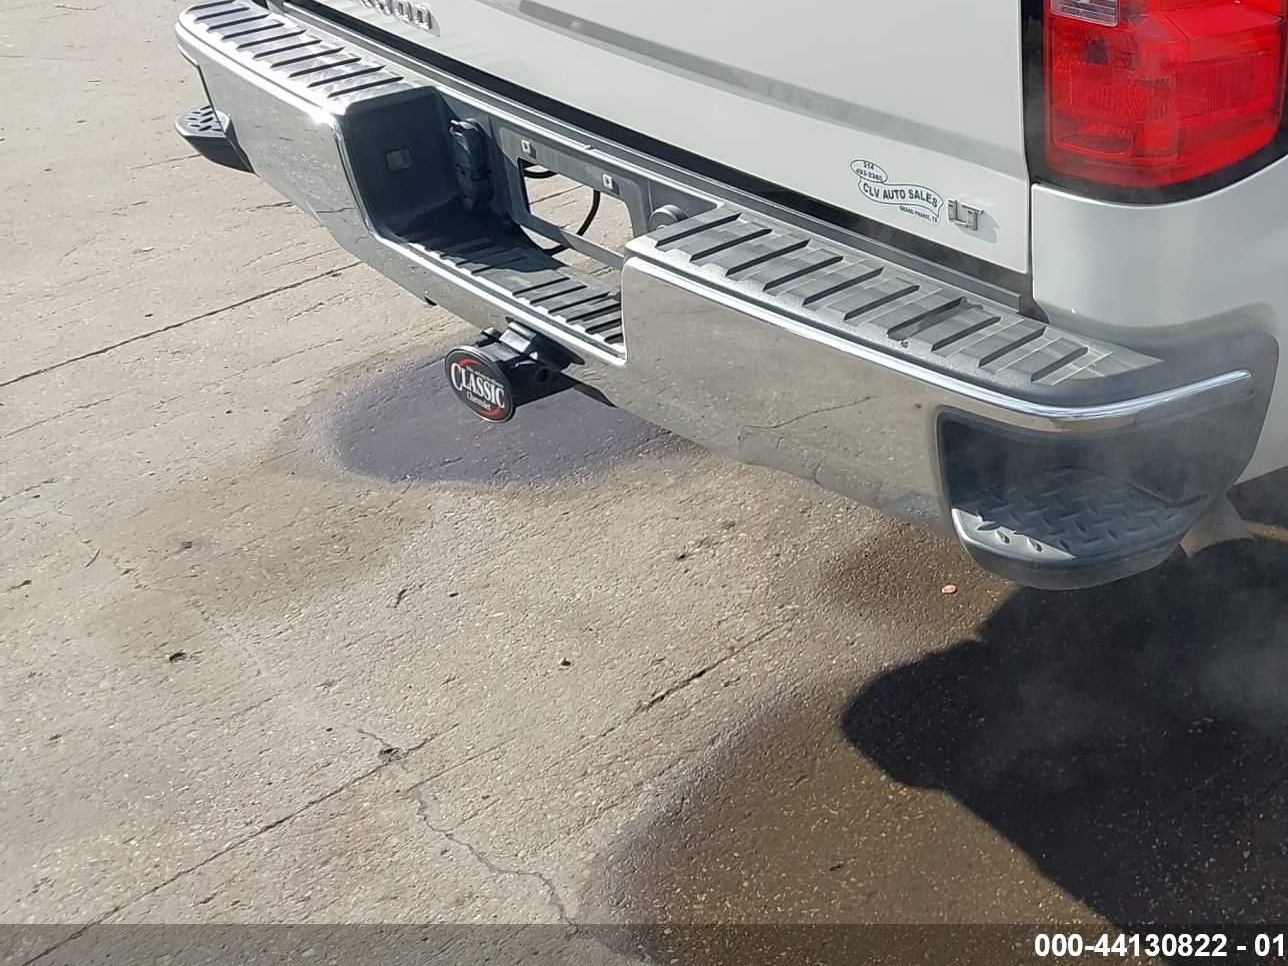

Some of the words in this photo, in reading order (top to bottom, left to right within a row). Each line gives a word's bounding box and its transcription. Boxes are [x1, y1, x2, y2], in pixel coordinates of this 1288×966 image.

[863, 182, 880, 199] CLV
[882, 189, 906, 200] AUTO
[908, 189, 938, 208] SALES
[948, 199, 984, 231] LT
[450, 362, 505, 409] CLASSIC
